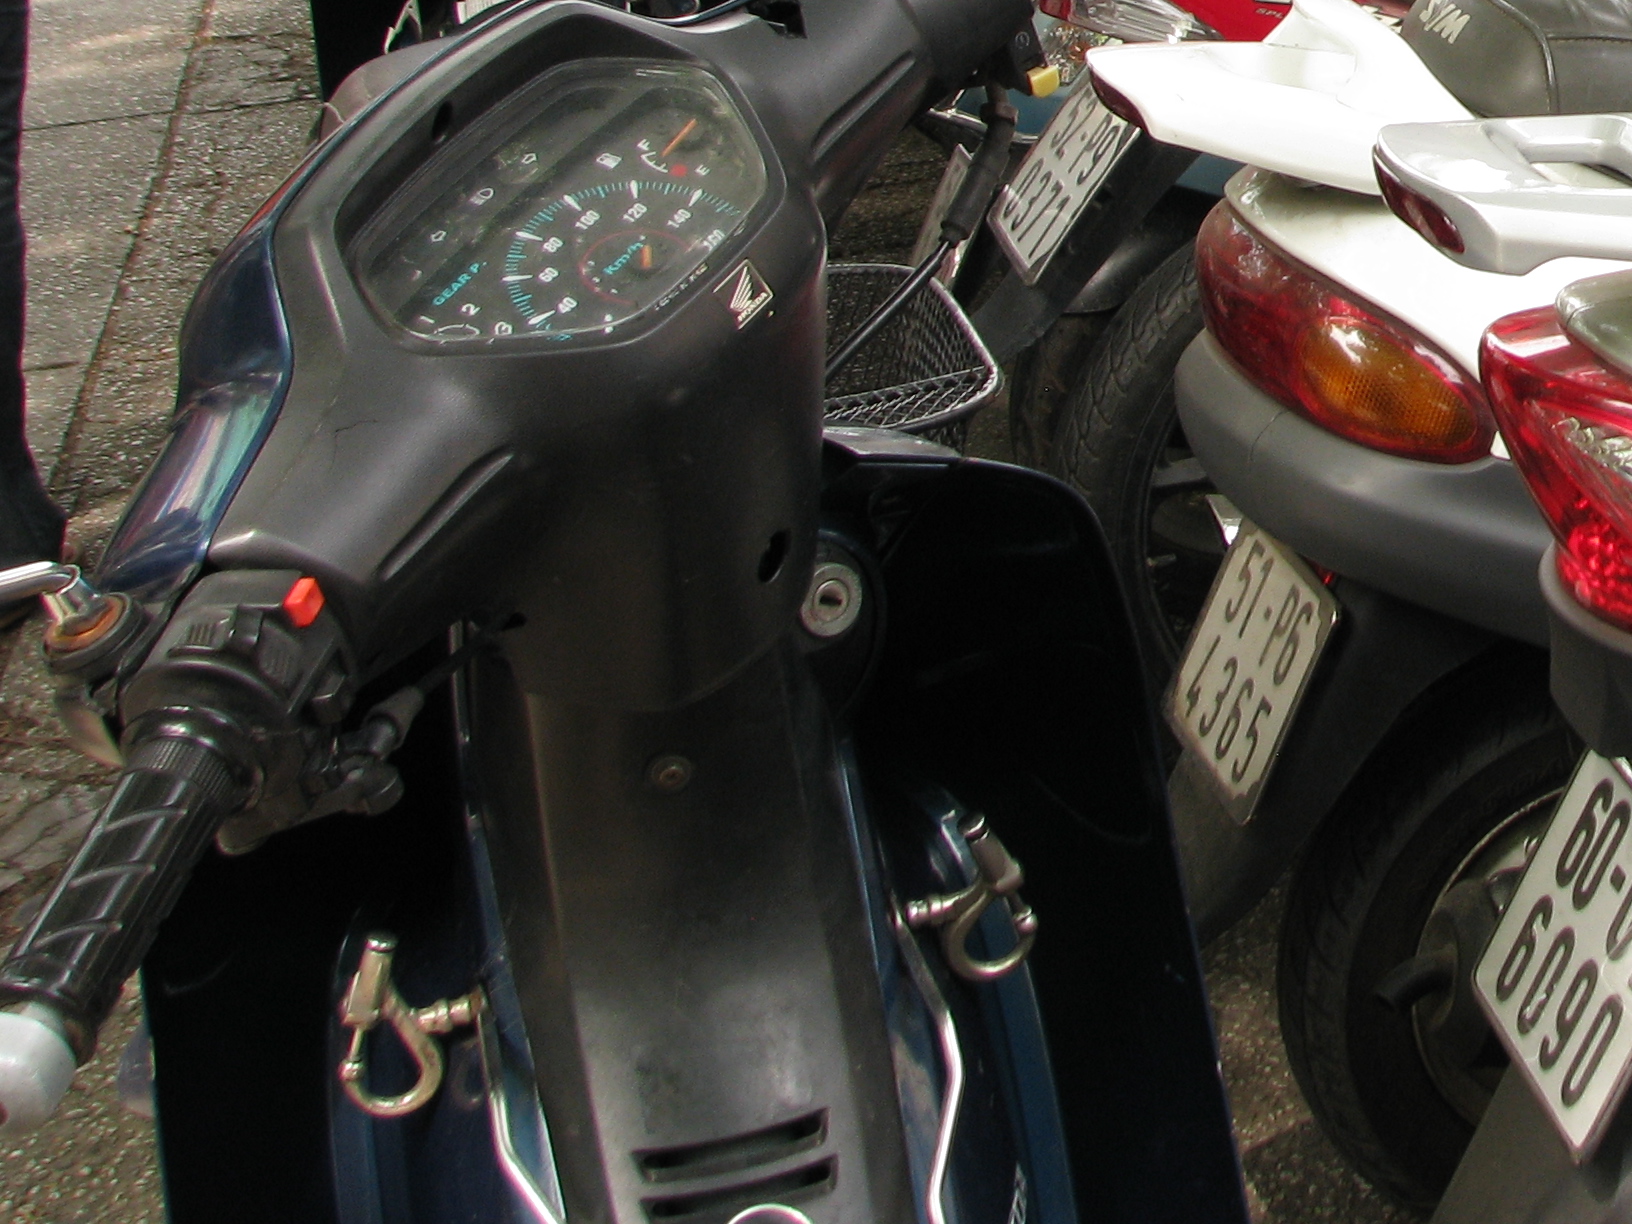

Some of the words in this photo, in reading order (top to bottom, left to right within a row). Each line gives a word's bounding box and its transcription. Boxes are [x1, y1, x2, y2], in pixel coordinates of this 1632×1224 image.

[575, 210, 601, 231] 100
[622, 202, 648, 223] 120
[667, 208, 693, 229] 140
[543, 237, 564, 253] 80
[538, 267, 559, 283] 60
[432, 272, 471, 305] GEAR
[557, 296, 578, 314] 40
[1225, 539, 1315, 687] 51-P6
[1185, 634, 1272, 784] 4365
[1496, 894, 1624, 1108] 6090
